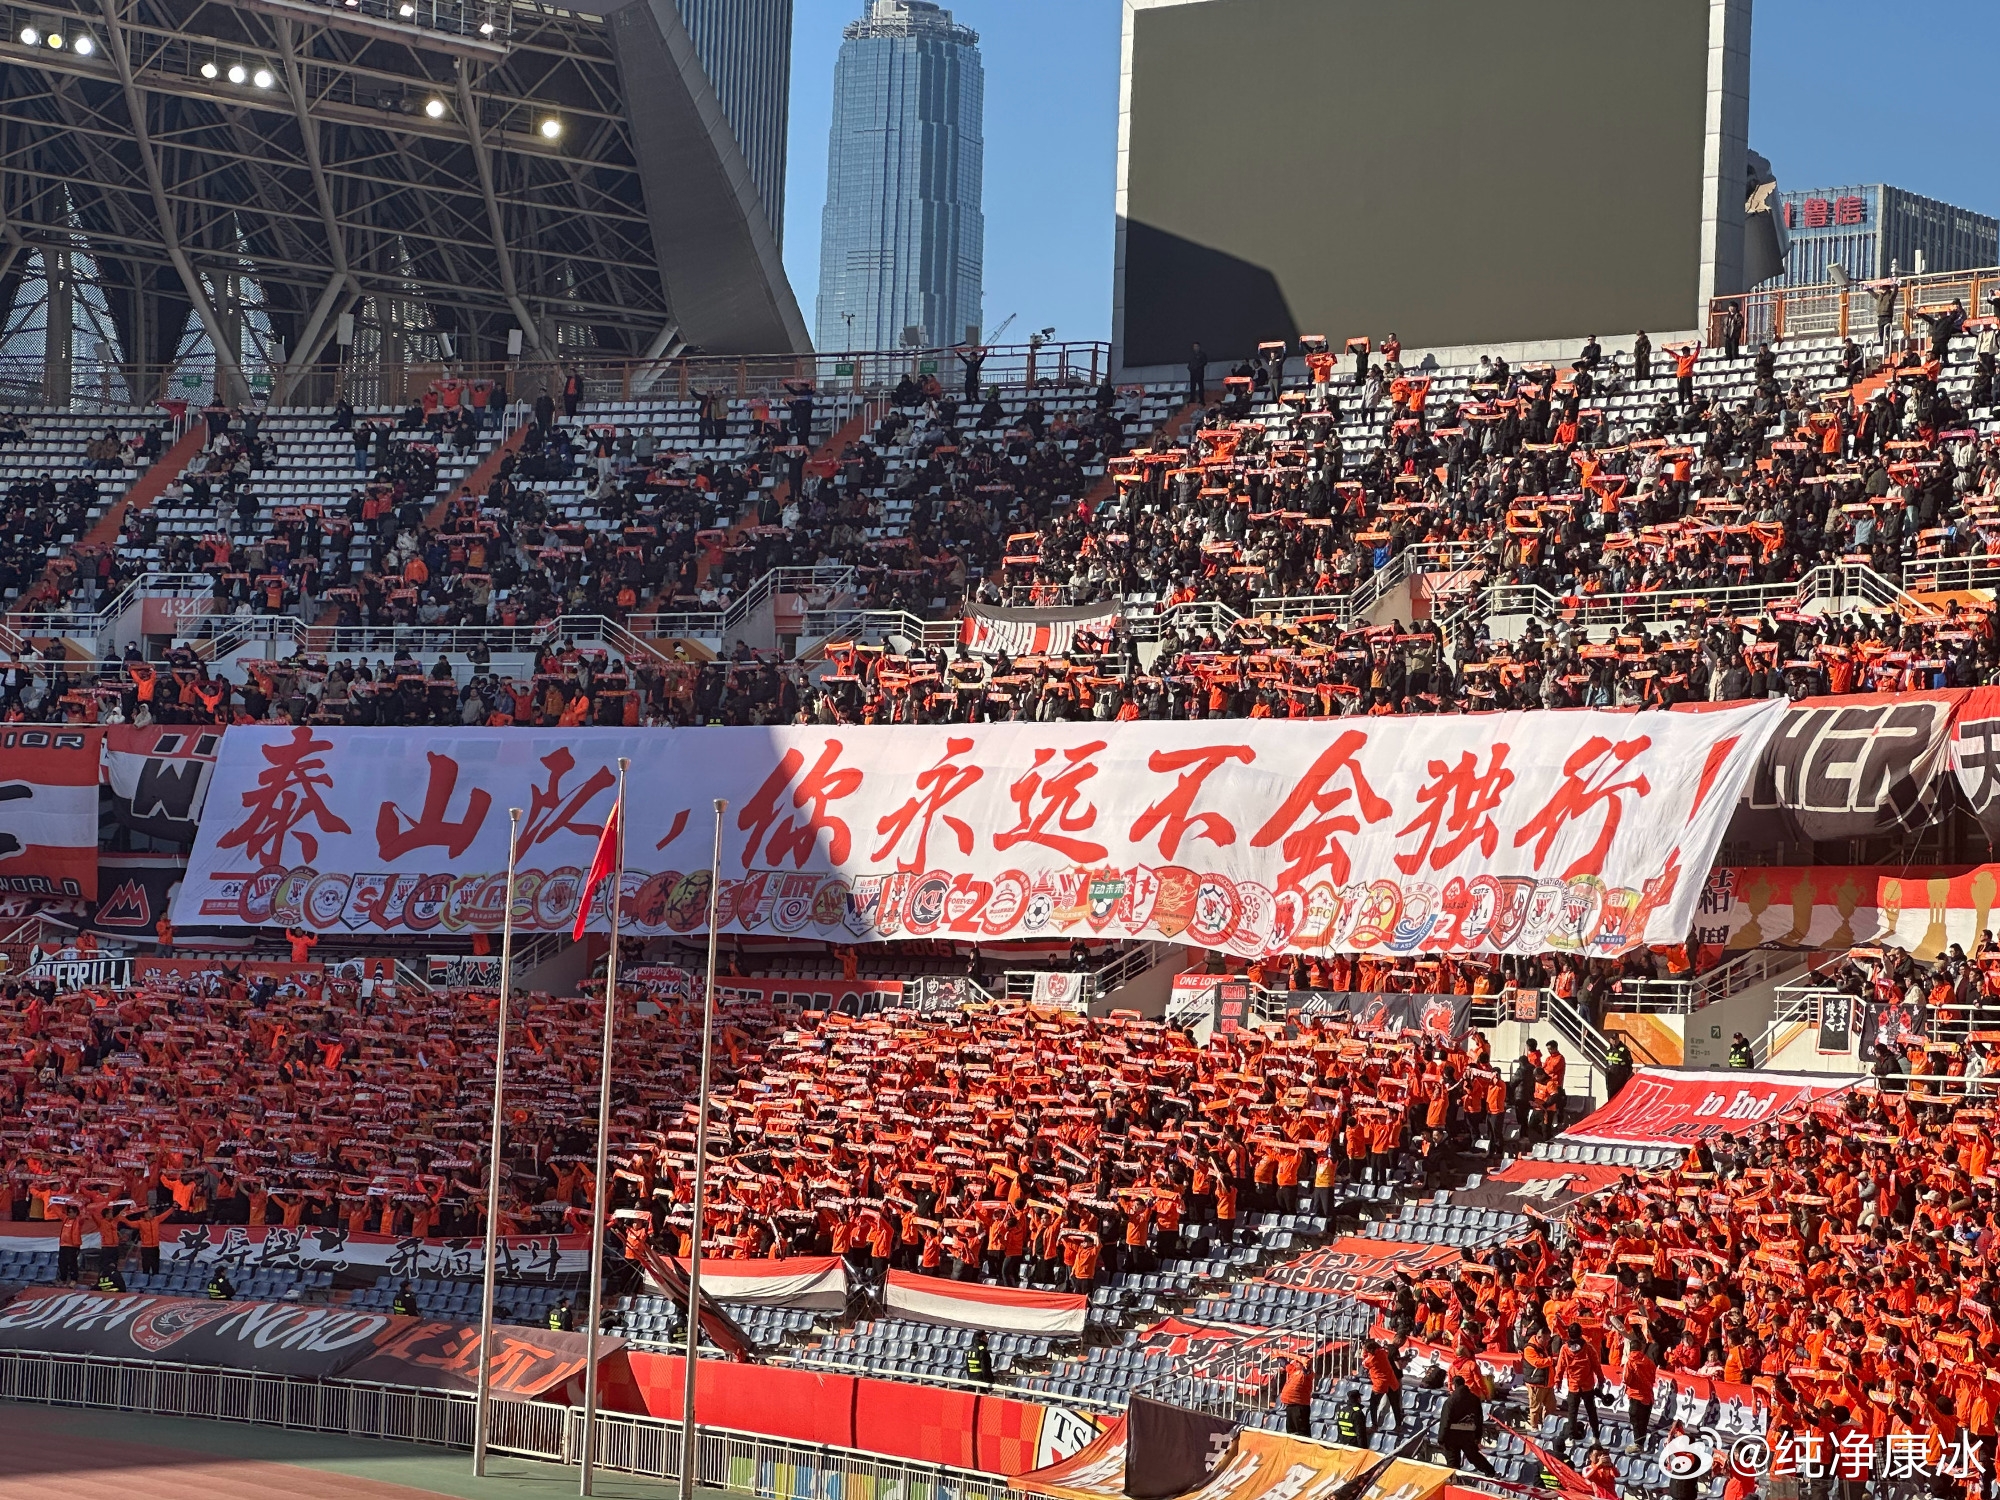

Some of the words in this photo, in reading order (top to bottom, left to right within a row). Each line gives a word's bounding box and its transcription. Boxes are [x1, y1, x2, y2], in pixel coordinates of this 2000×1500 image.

[0, 732, 84, 748] IOR
[217, 727, 1743, 888] 泰山队，你永远不会独行！
[1180, 977, 1200, 985] ONE
[1693, 1091, 1725, 1117] to
[1720, 1090, 1778, 1121] End
